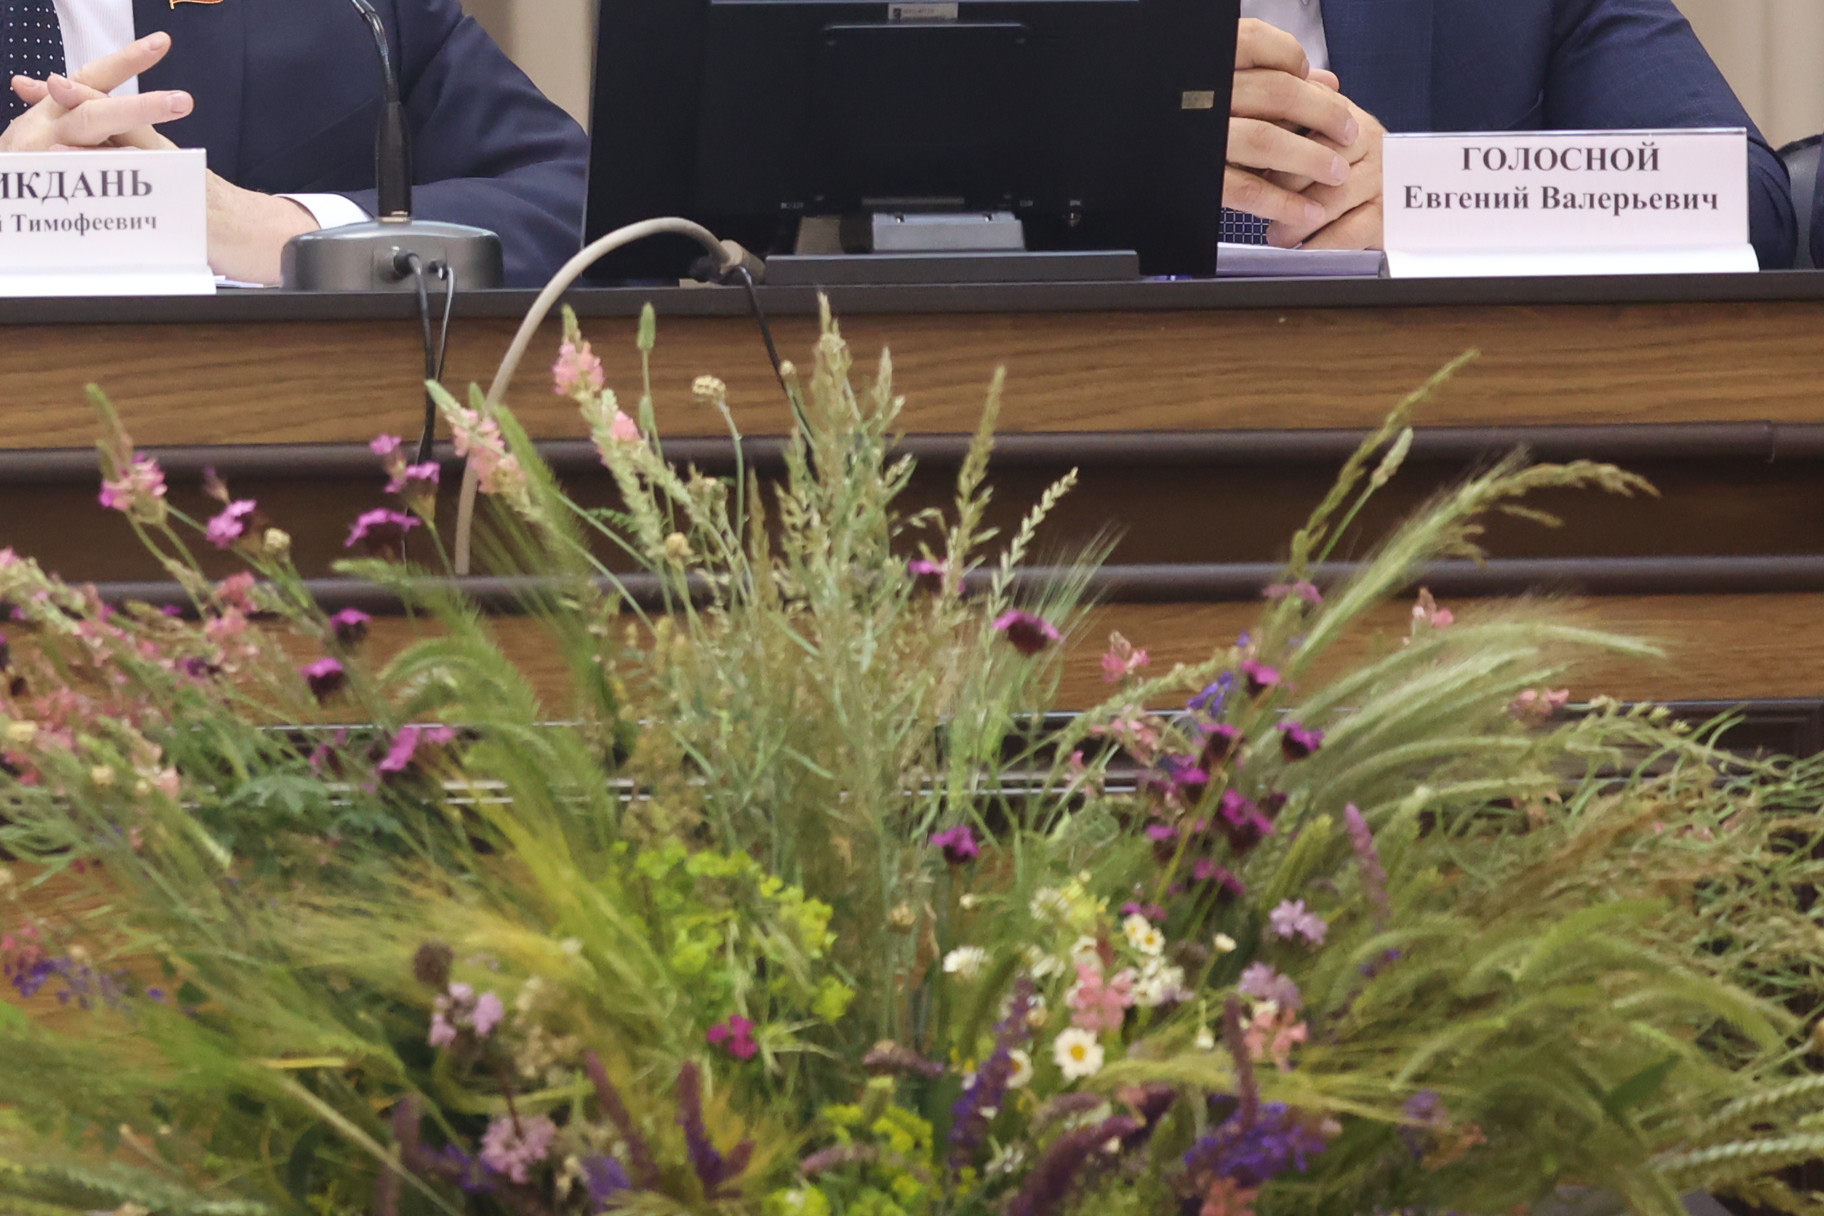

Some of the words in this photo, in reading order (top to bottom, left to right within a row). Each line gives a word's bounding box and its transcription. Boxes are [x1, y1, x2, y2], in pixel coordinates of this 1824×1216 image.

[1460, 141, 1661, 172] ГОЛОСНОЙ
[1402, 184, 1530, 211] Евгений
[1540, 184, 1720, 217] Валерьевич
[10, 212, 158, 237] Тимофеевич
